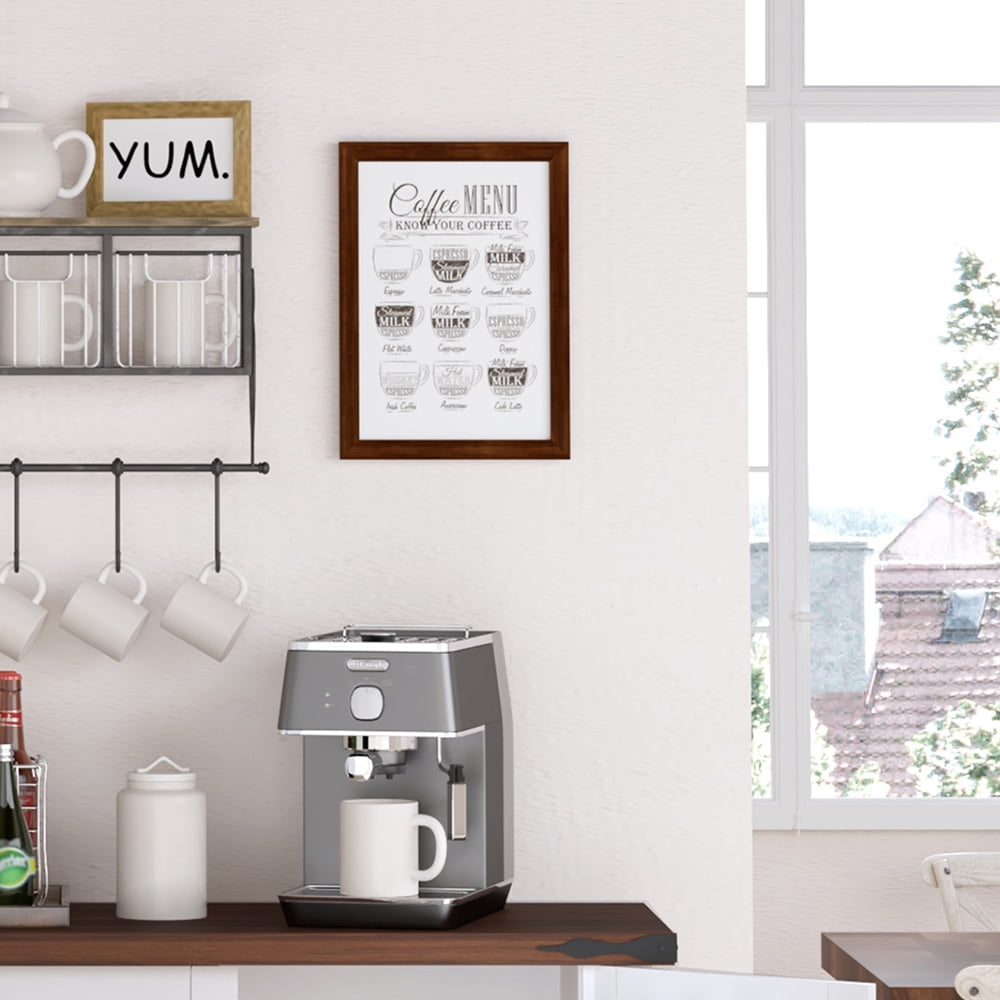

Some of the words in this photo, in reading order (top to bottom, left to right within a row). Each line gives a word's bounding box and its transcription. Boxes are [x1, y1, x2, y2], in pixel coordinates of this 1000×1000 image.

[109, 139, 229, 179] YUM.
[389, 182, 459, 227] Coffee
[463, 184, 518, 215] MENU
[395, 219, 429, 231] KNOW
[433, 219, 464, 231] YOUR
[467, 219, 513, 231] COFFEE
[489, 252, 523, 264] MILK
[433, 305, 451, 316] Milk
[379, 316, 411, 327] MILK
[434, 318, 466, 328] MILK
[491, 376, 523, 386] MILK
